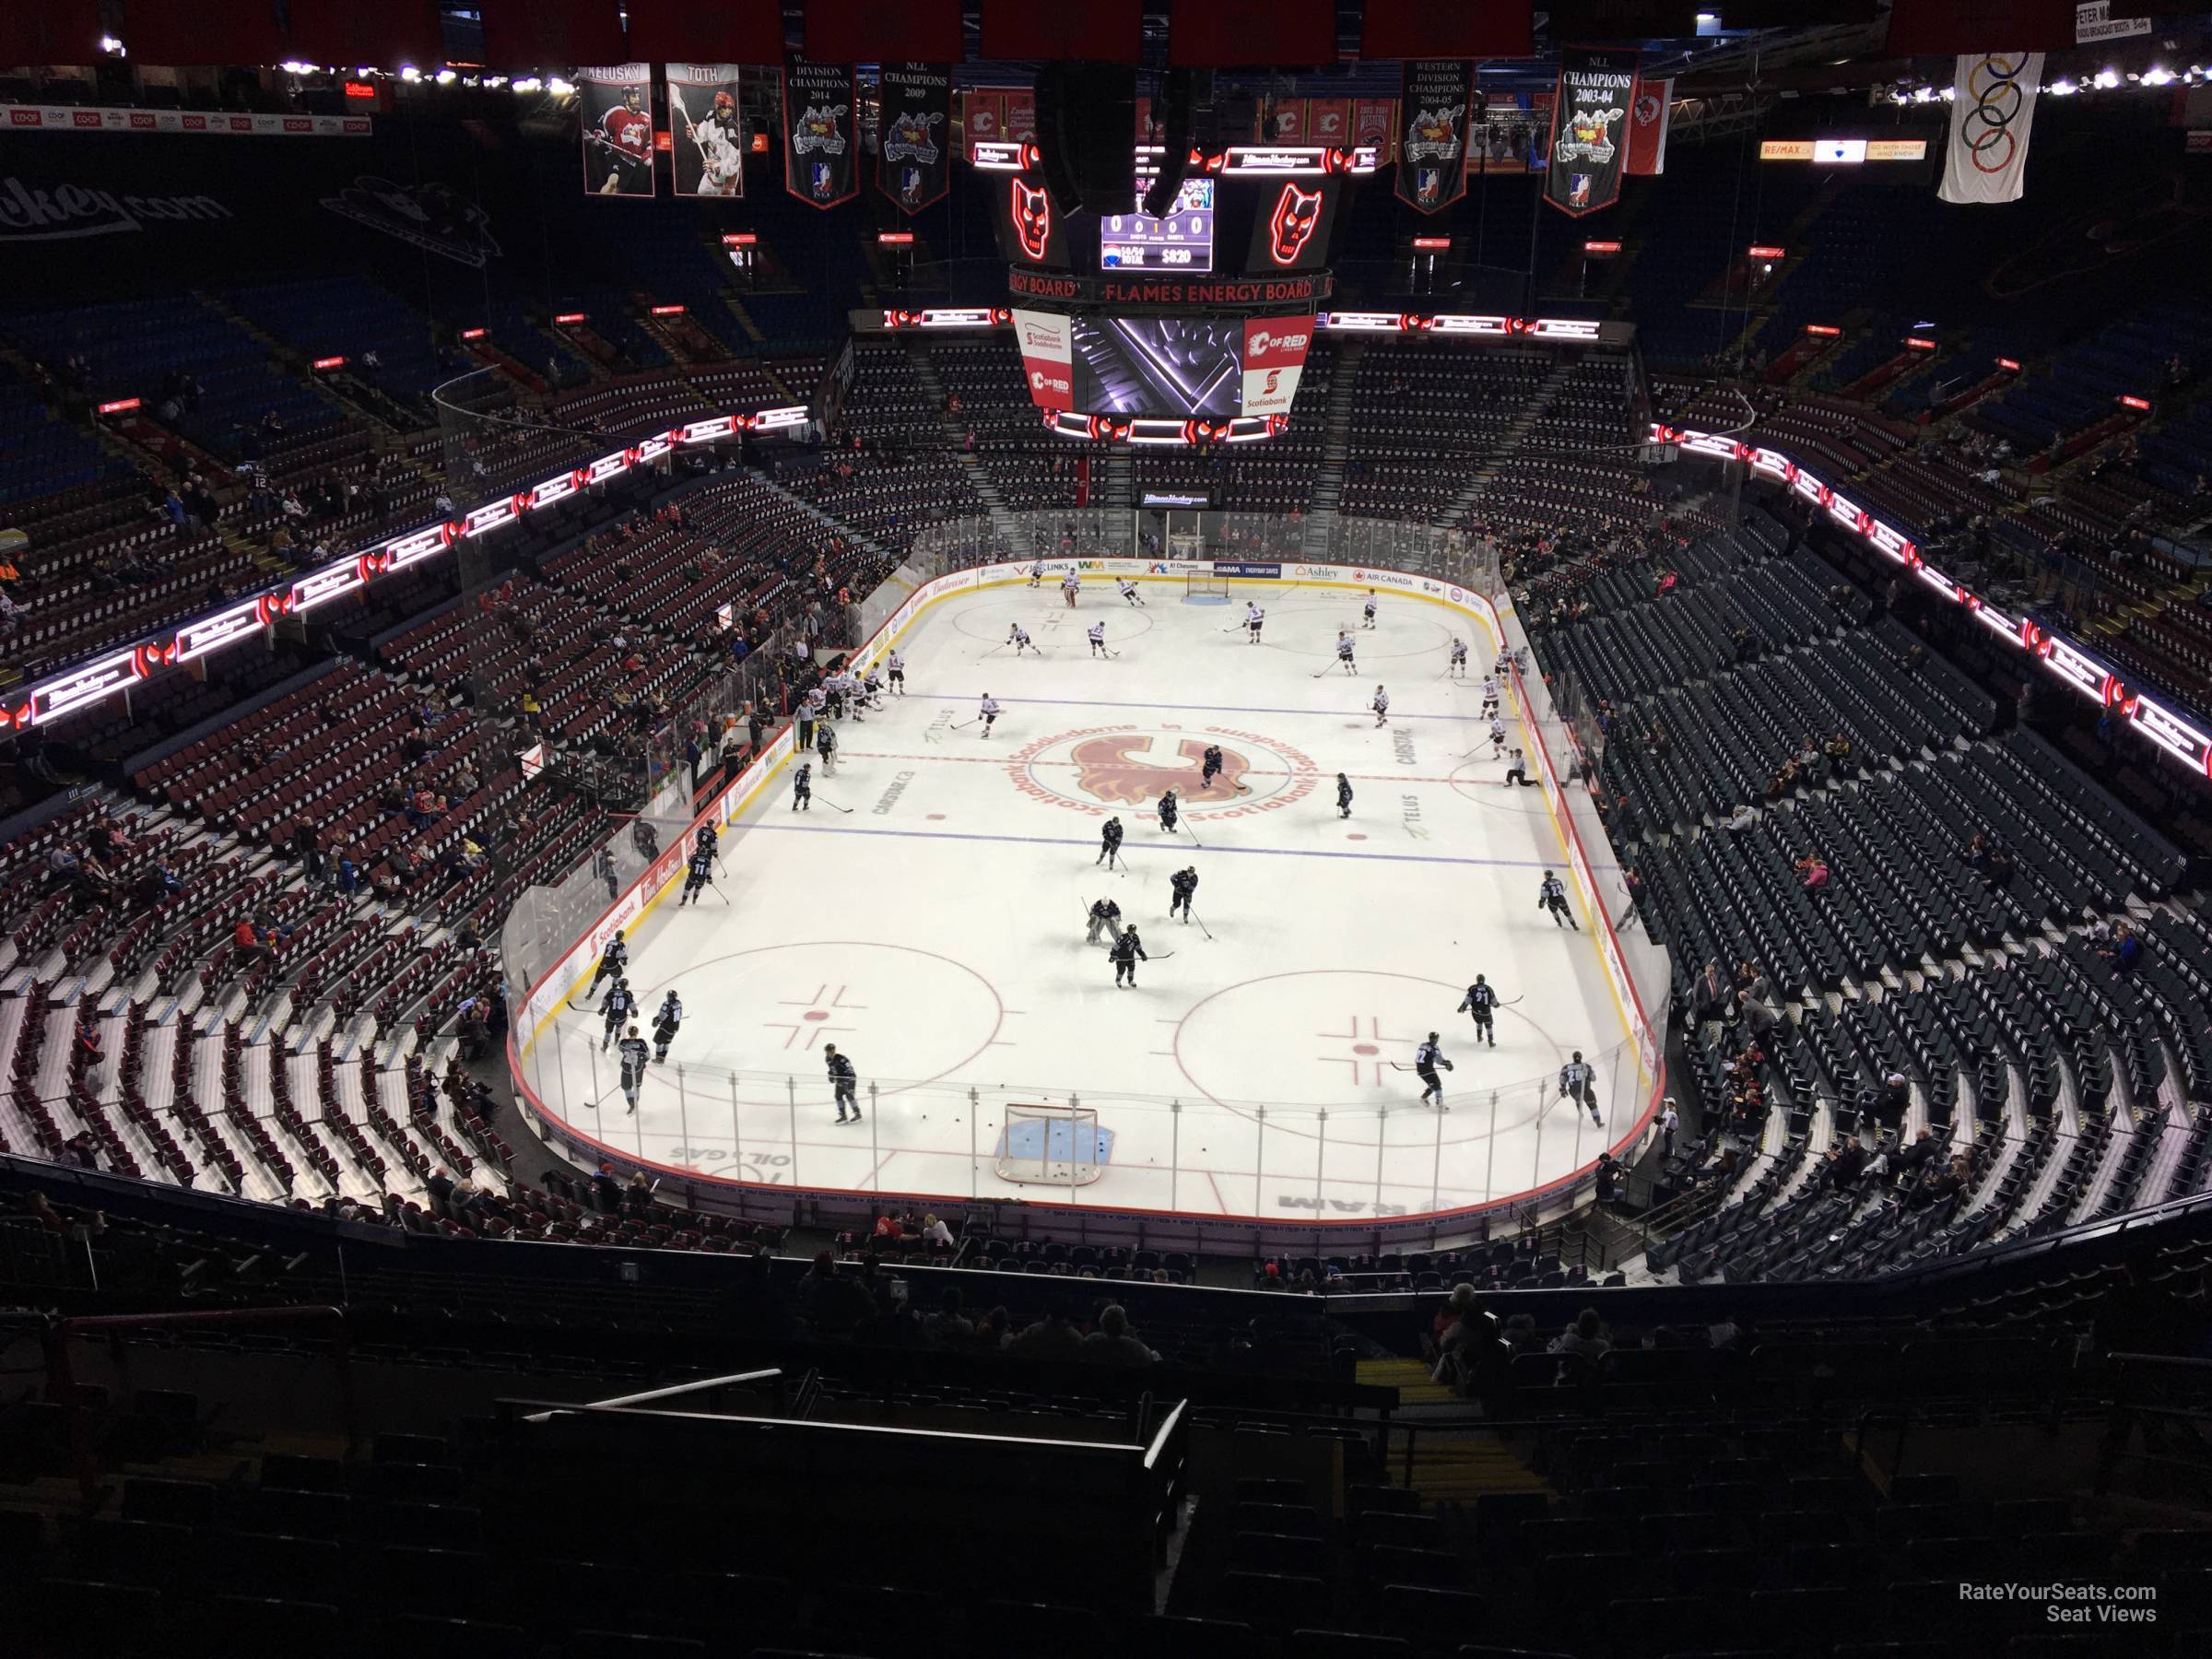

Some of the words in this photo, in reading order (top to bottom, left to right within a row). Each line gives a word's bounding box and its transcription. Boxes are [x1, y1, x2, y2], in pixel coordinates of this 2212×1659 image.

[906, 62, 927, 71] NLL
[1416, 62, 1461, 72] WESTERN
[1589, 57, 1609, 66] NLL
[588, 65, 641, 81] KELUSKY
[687, 66, 718, 81] TOTH
[796, 66, 841, 76] DIVISION
[1418, 73, 1460, 83] DIVISION
[790, 77, 850, 88] CHAMPIONS
[885, 72, 947, 87] CHAMPIONS
[1563, 71, 1631, 88] CHAMPIONS
[810, 90, 830, 100] 2014
[905, 88, 925, 98] 2009
[1408, 84, 1465, 93] CHAMPIONS
[1575, 88, 1614, 103] 2003-04
[1419, 95, 1453, 104] 2004-05
[1191, 217, 1202, 234] 0
[1031, 277, 1077, 298] BOARD
[1107, 283, 1180, 303] FLAMES
[1187, 284, 1261, 302] ENERGY
[1266, 280, 1312, 300] BOARD
[1270, 337, 1283, 347] OF
[1282, 334, 1308, 348] RED
[1053, 379, 1070, 391] RED
[1248, 395, 1288, 407] Scotiabank
[1047, 563, 1070, 572] LINKS
[1307, 567, 1339, 580] Ashley
[1366, 572, 1381, 581] AIR
[1380, 573, 1413, 586] CANADA
[1008, 725, 1137, 760] Saddledome
[1205, 726, 1319, 773] Saddledome
[1002, 765, 1109, 817] Scotiabank
[1186, 777, 1319, 822] Scotiabank
[600, 900, 635, 945] Scotiabank
[747, 1152, 792, 1168] OIL
